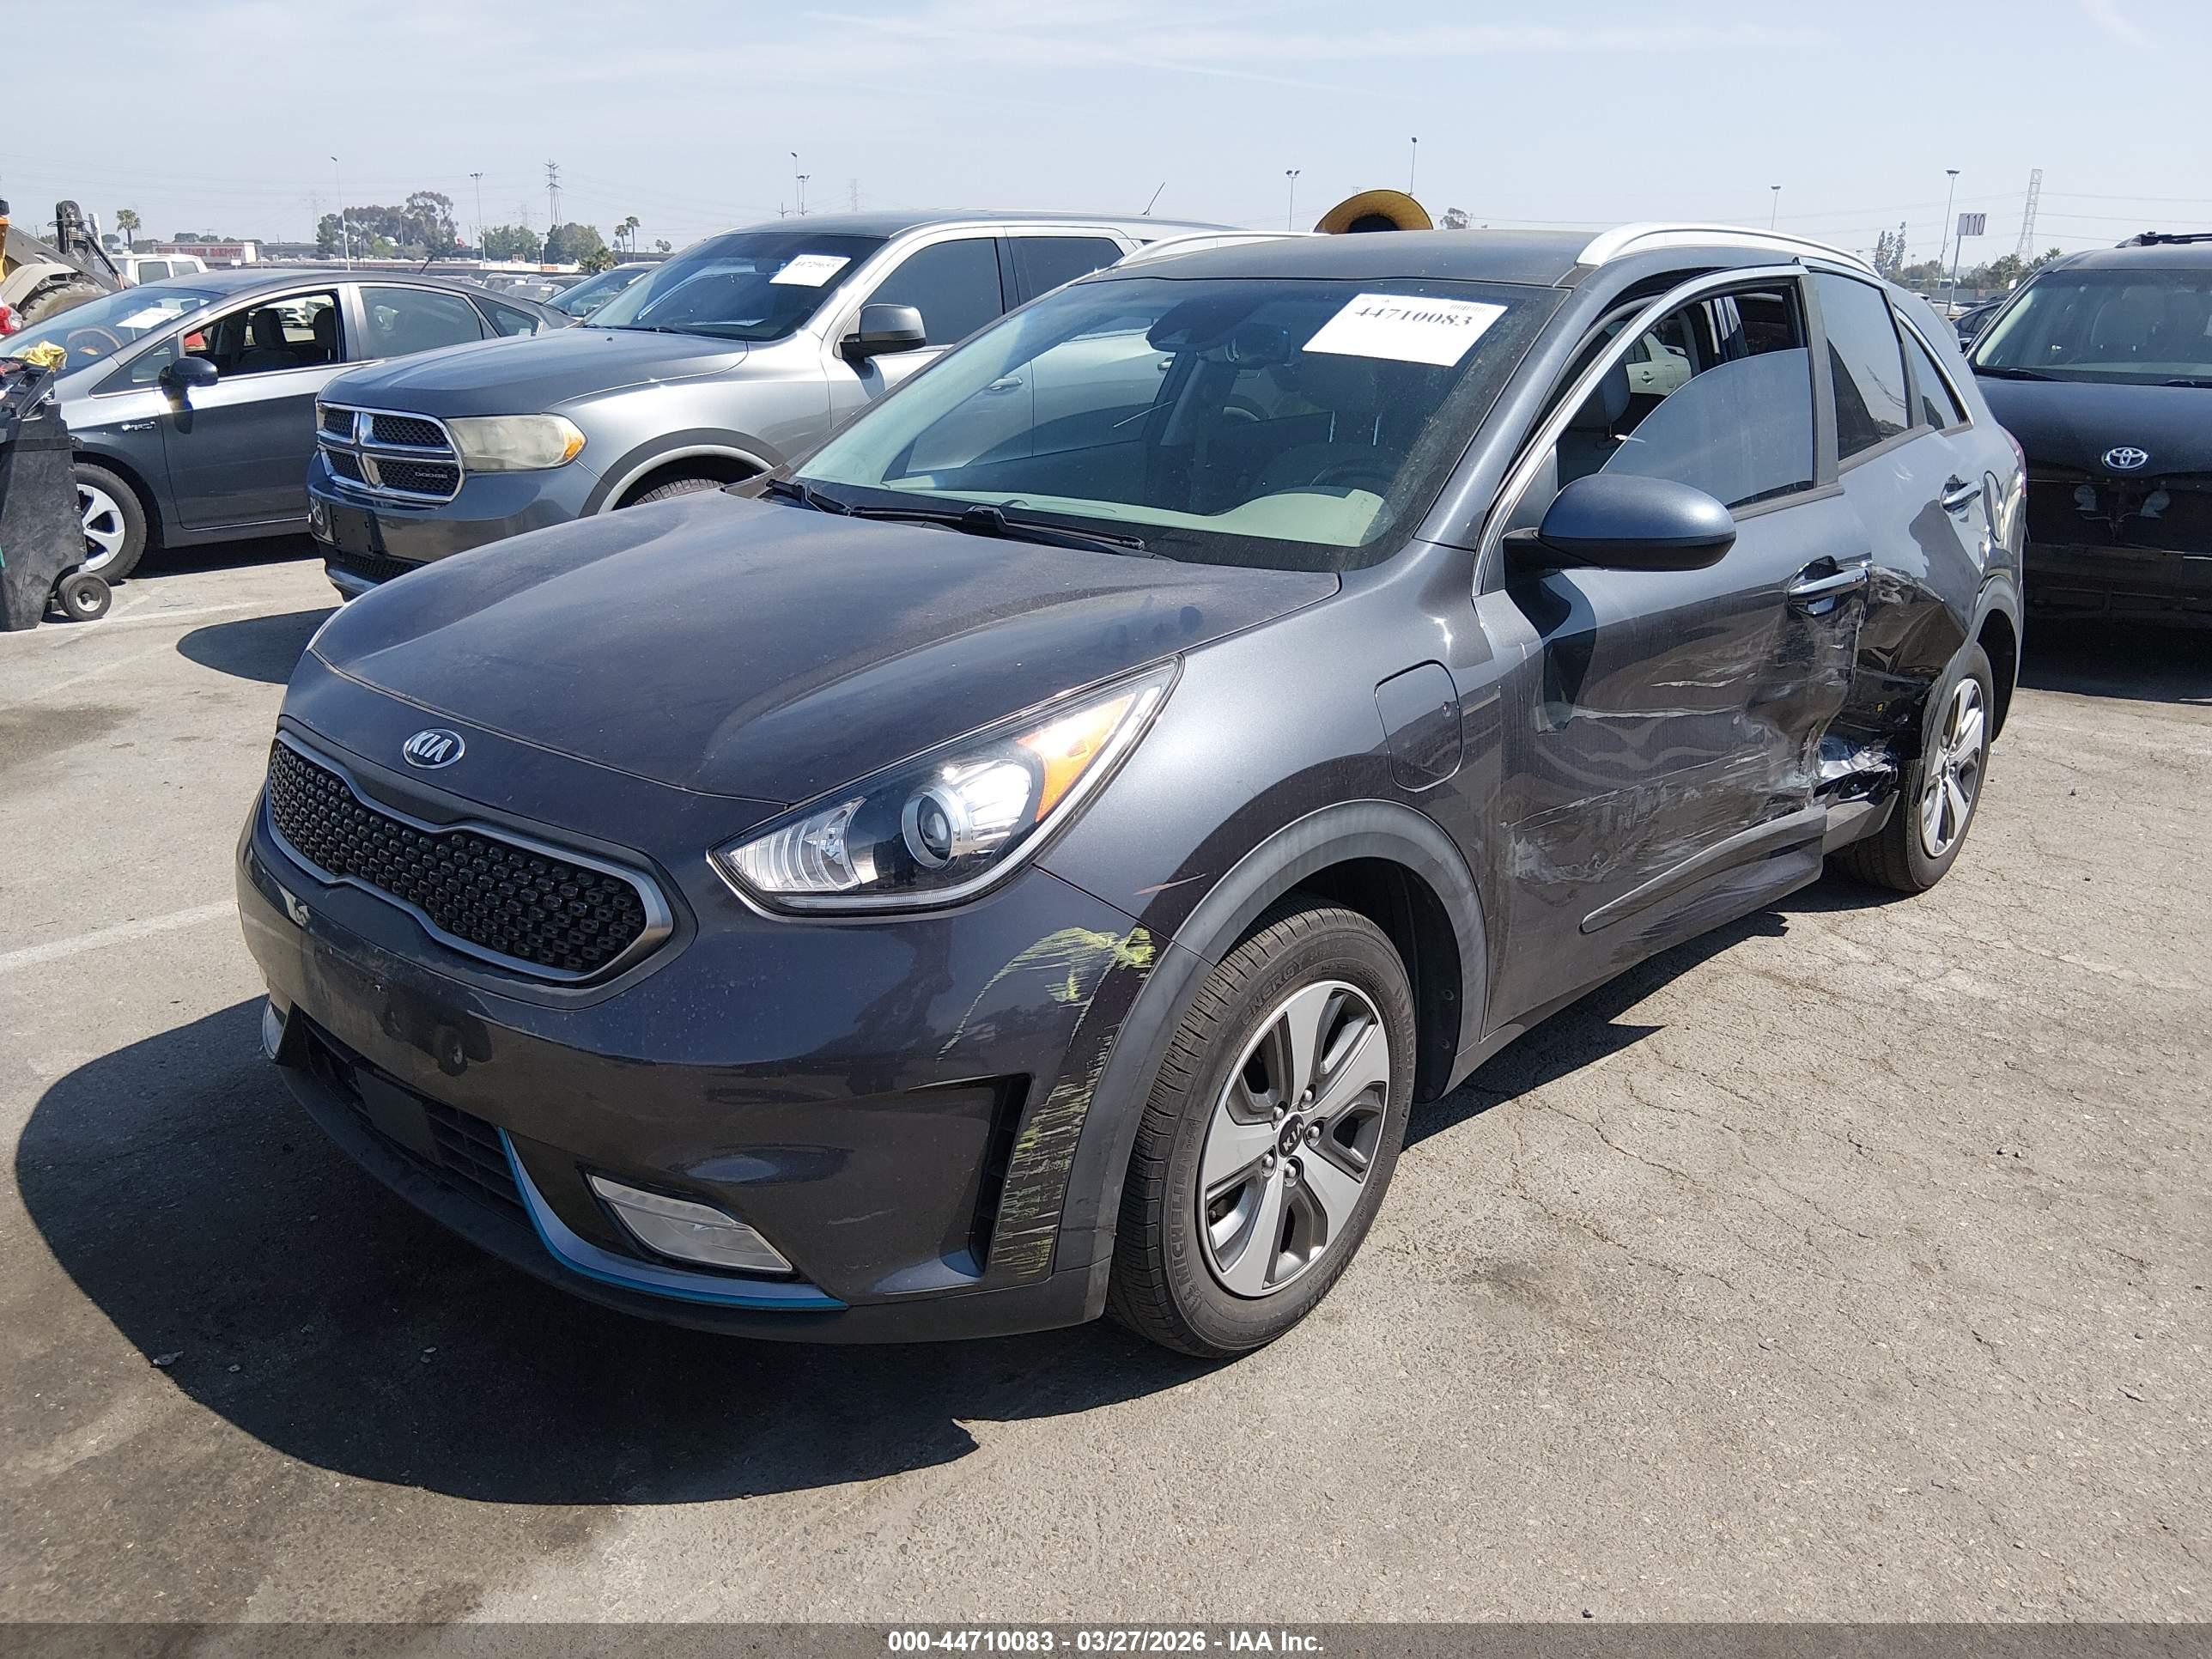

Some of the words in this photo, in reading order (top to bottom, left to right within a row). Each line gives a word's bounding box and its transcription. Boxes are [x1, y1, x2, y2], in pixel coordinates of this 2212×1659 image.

[1965, 213, 1985, 235] 110
[1355, 307, 1473, 325] 44710083
[407, 732, 453, 763] KIA
[1282, 1121, 1304, 1152] KIA
